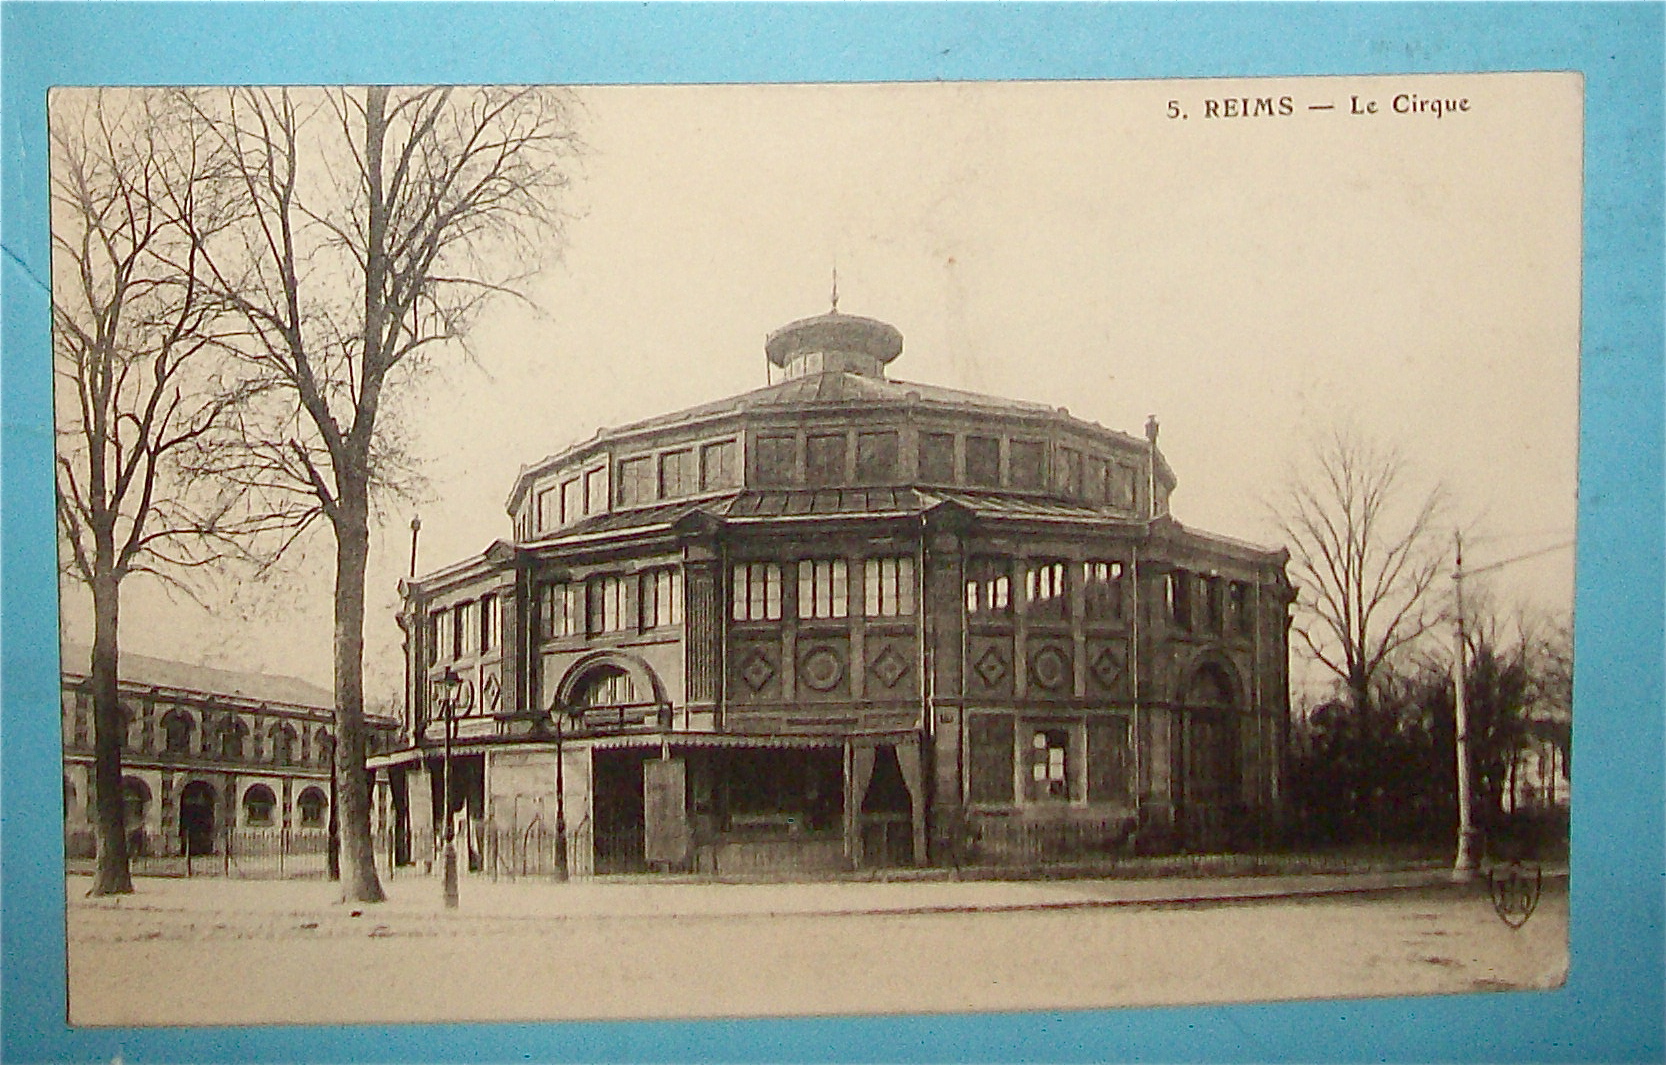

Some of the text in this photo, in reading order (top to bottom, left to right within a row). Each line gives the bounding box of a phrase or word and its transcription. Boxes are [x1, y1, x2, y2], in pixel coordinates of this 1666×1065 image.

[1166, 100, 1188, 119] 5.
[1204, 96, 1294, 118] REIMS
[1351, 95, 1379, 115] Le
[1392, 94, 1471, 119] Cirque
